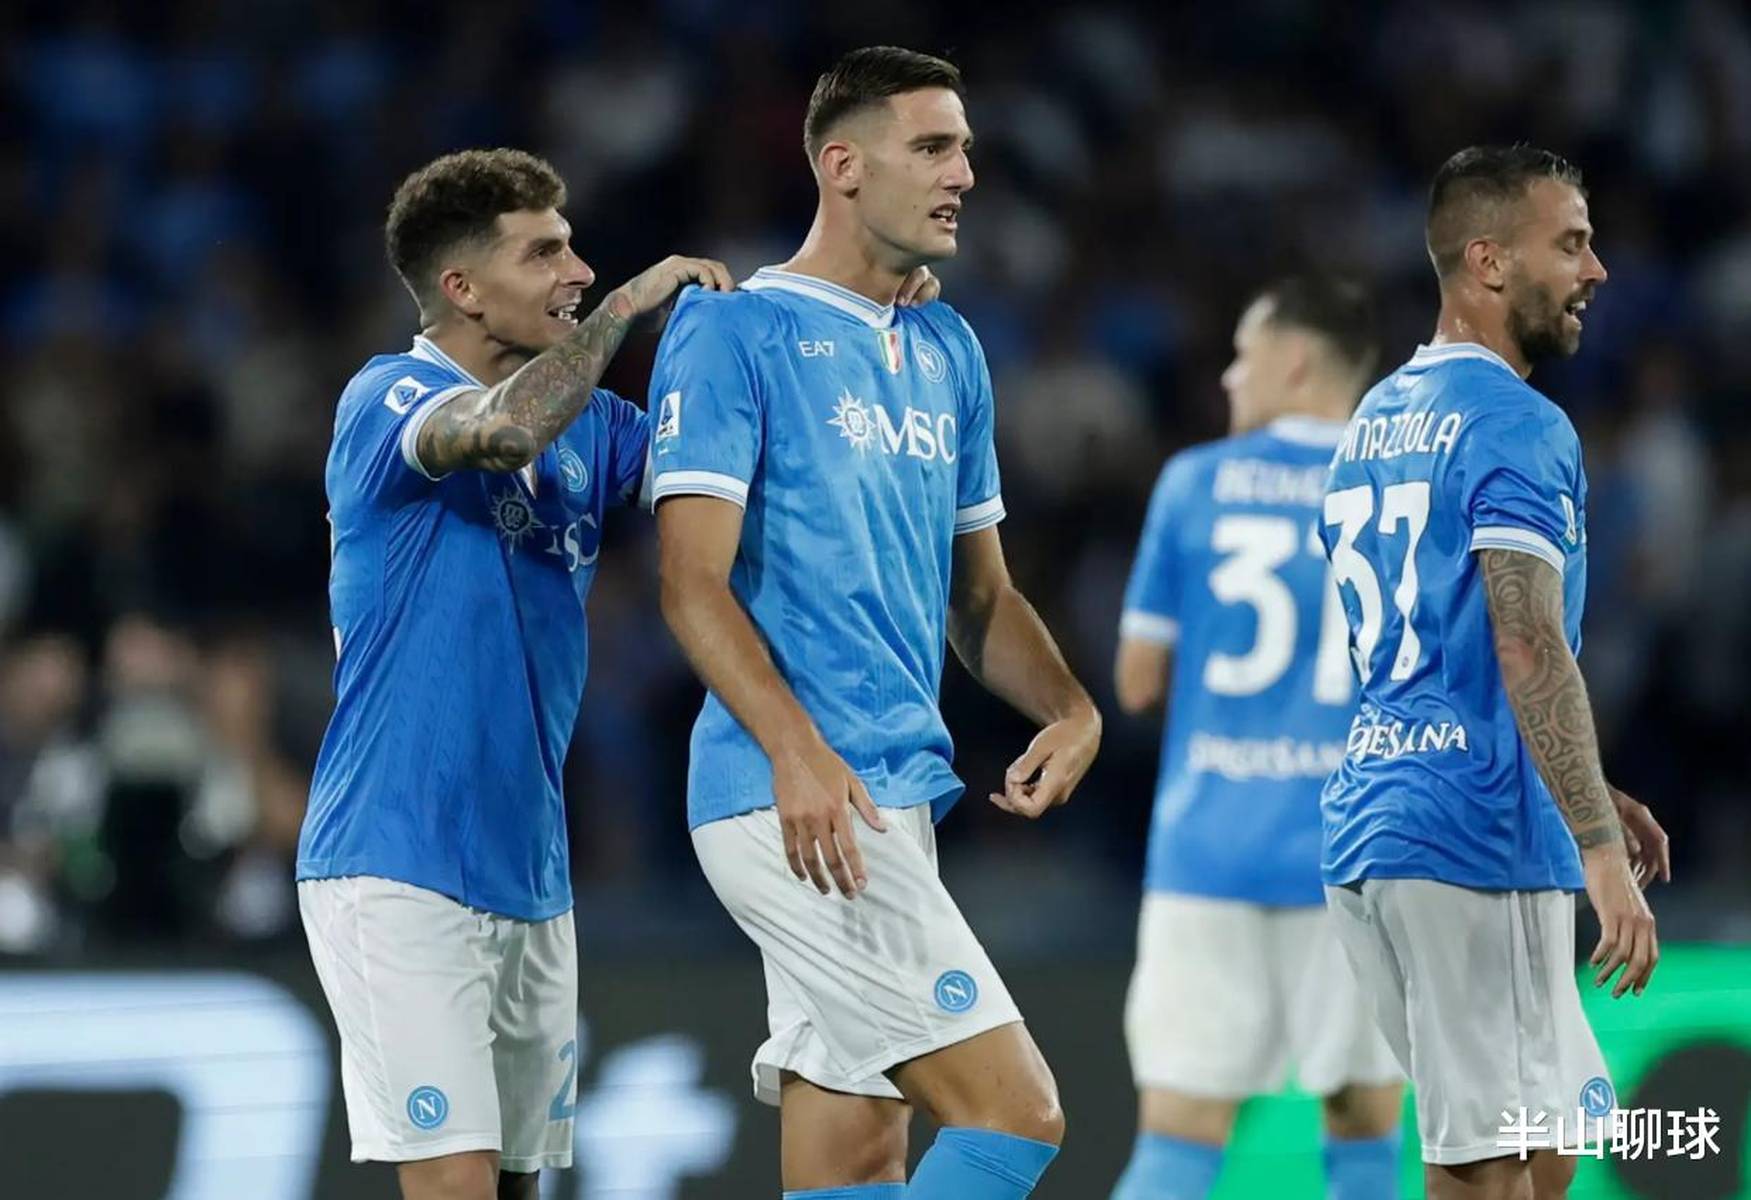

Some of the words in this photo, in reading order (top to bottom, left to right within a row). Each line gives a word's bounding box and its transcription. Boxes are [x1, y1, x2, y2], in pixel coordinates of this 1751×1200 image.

[798, 340, 834, 357] EA7
[872, 403, 956, 465] MSC
[1329, 410, 1461, 469] PINAZZOLA
[1324, 481, 1430, 684] 37
